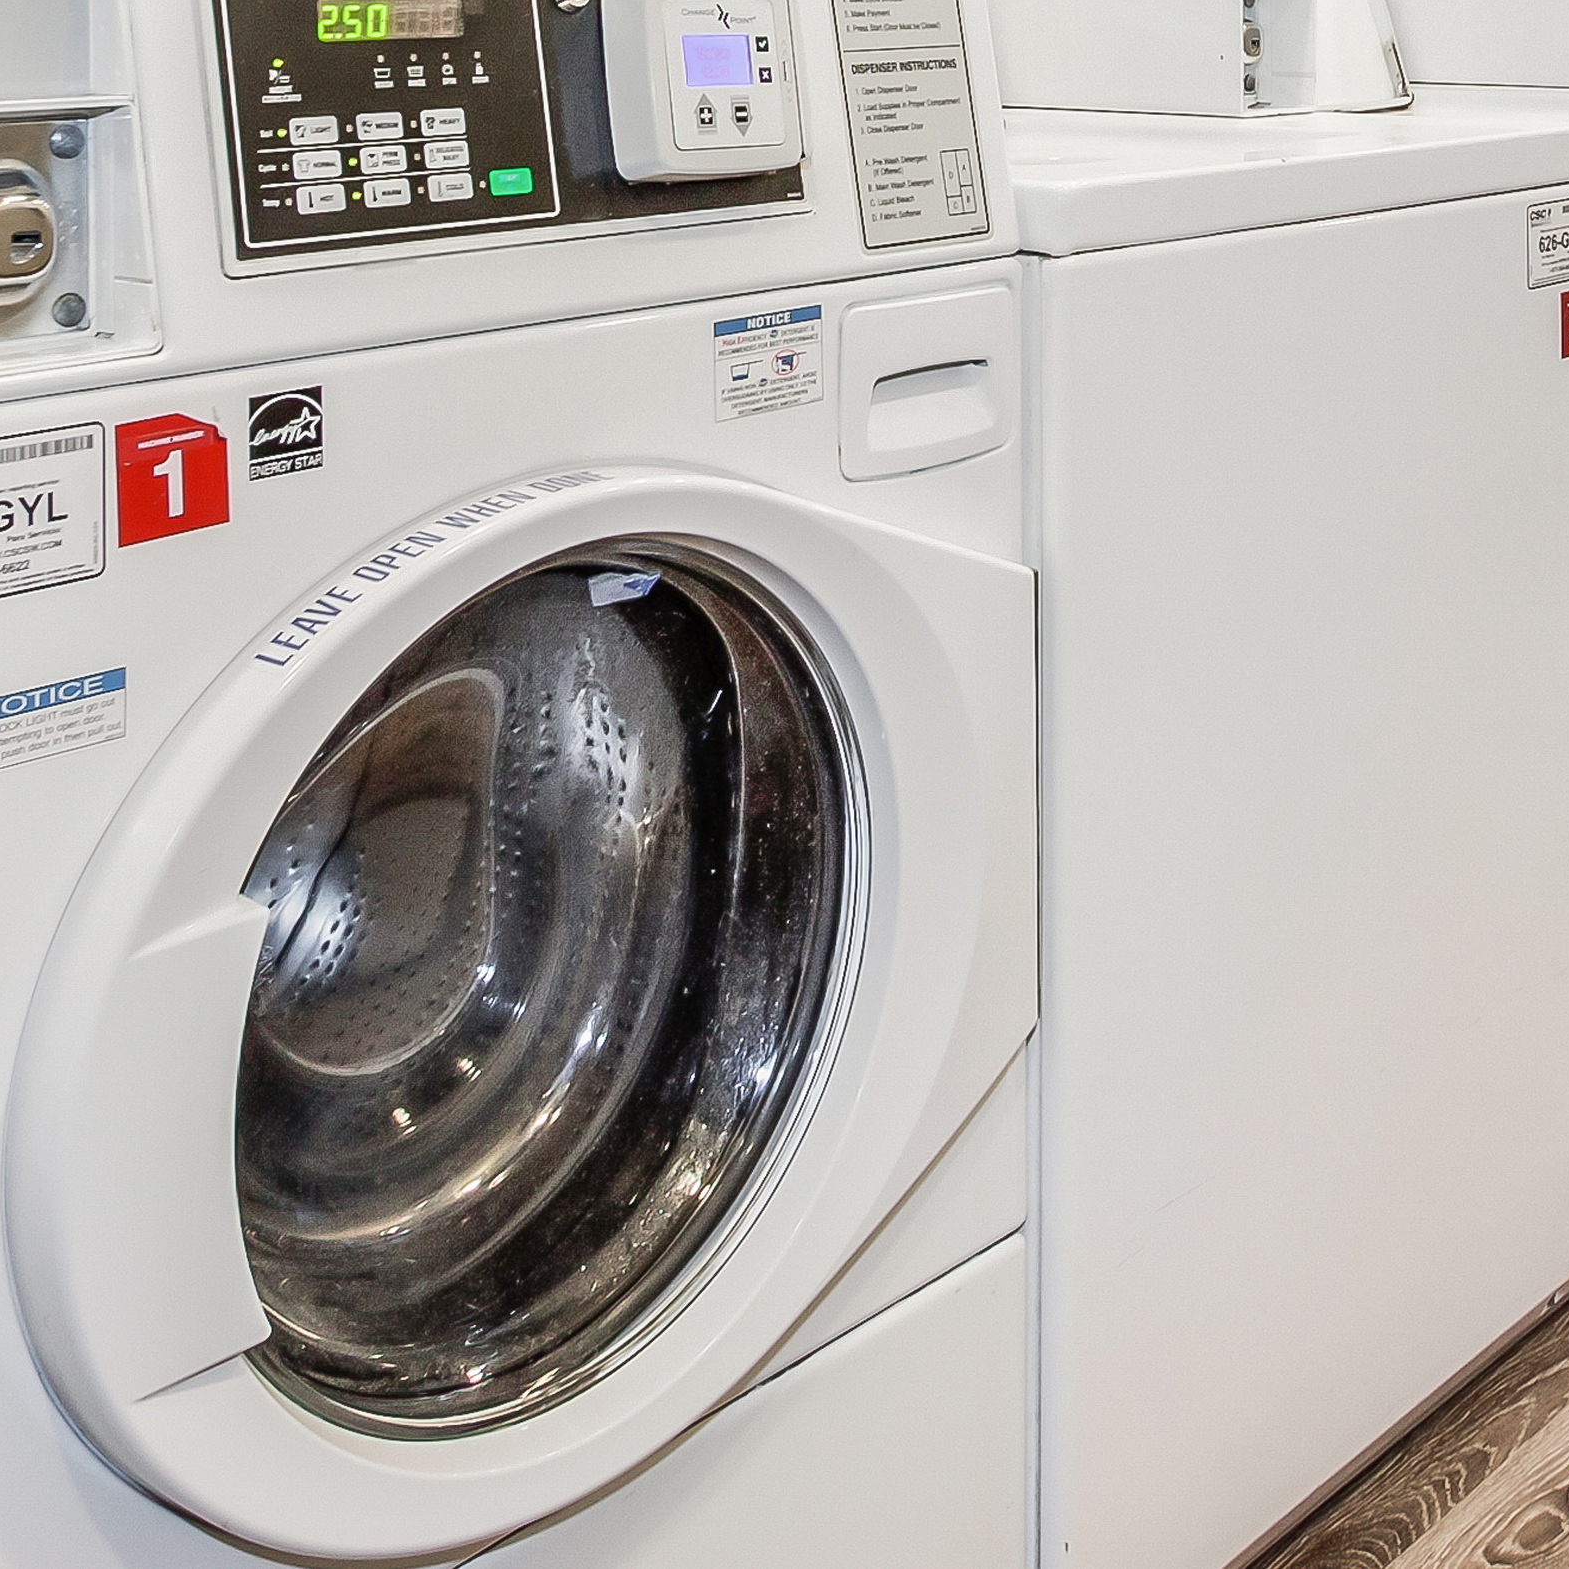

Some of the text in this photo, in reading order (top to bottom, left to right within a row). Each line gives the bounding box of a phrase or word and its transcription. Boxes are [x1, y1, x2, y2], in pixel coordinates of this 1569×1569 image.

[317, 4, 388, 41] 2.50
[851, 58, 957, 74] DISPENSER INSTRUCTIONS
[747, 312, 791, 329] NOTICE
[250, 453, 323, 479] ENERGY STAR
[153, 449, 184, 519] 1
[254, 470, 616, 667] LEAVE OPEN WHEN DONE
[25, 710, 58, 728] LIGHT
[60, 704, 84, 719] must
[101, 697, 116, 708] out
[43, 724, 55, 734] to
[56, 718, 81, 733] open
[1, 745, 27, 761] push
[28, 738, 51, 752] door
[64, 729, 86, 742] then
[87, 725, 105, 739] pull
